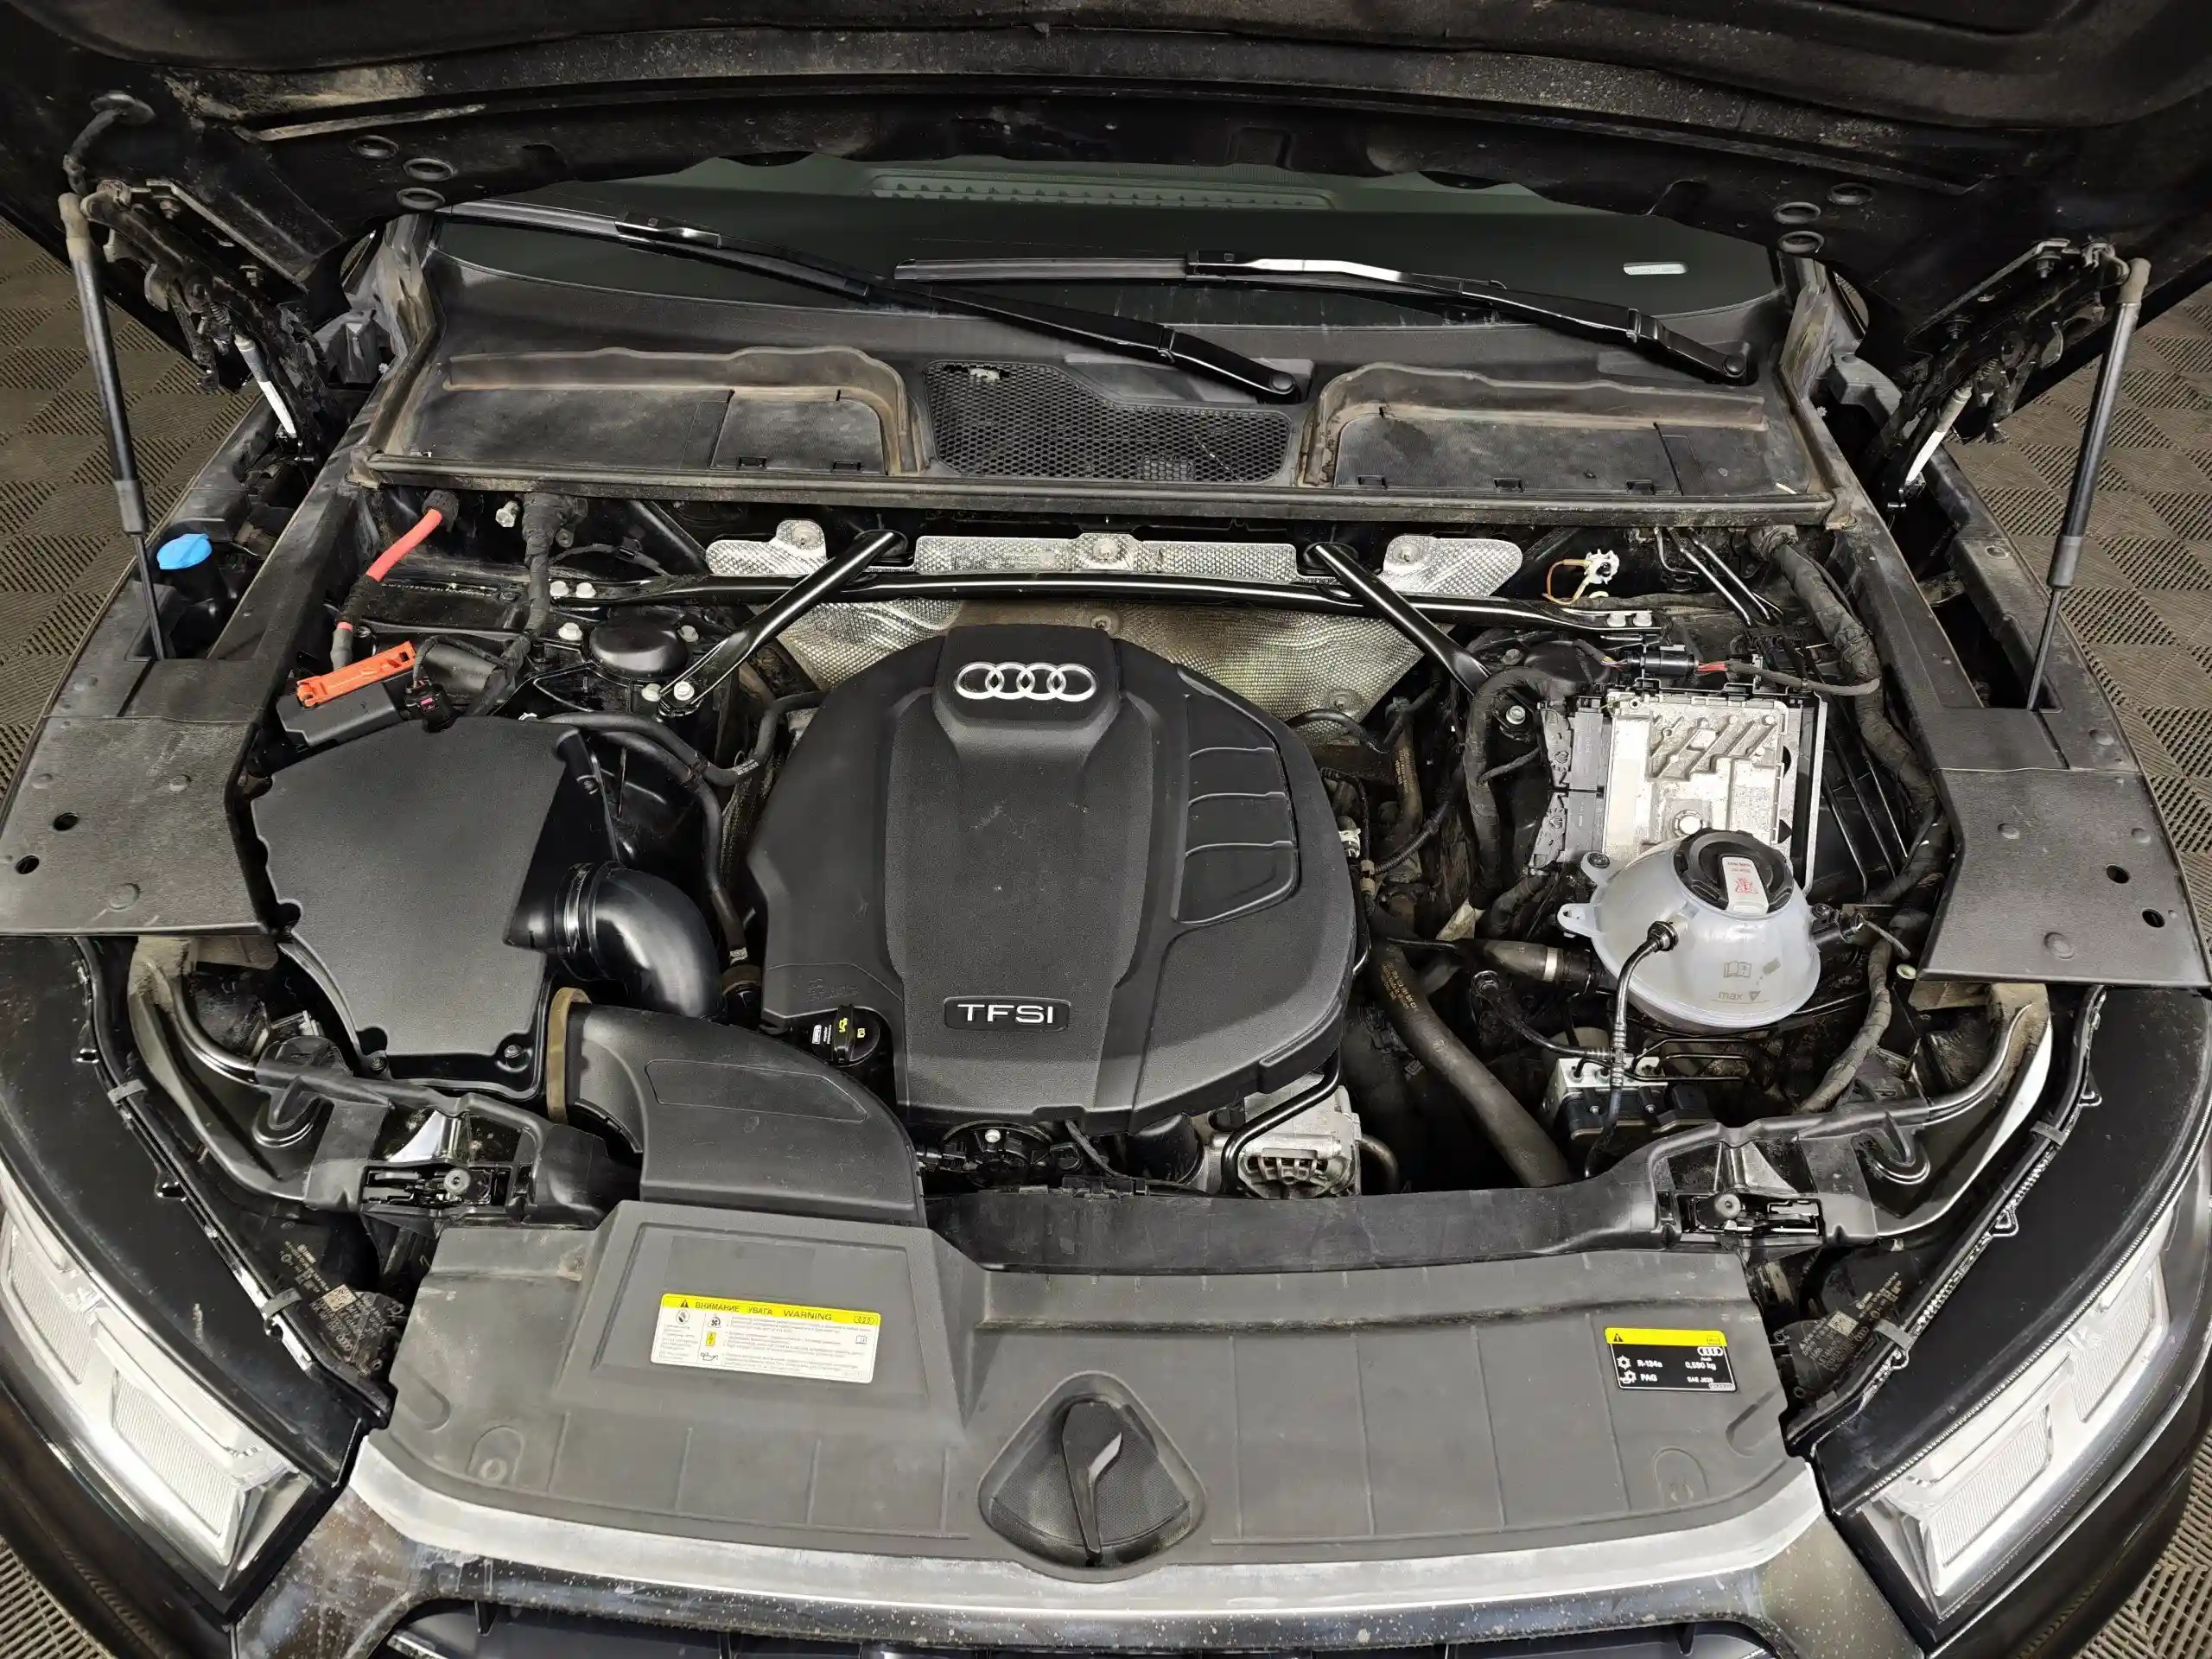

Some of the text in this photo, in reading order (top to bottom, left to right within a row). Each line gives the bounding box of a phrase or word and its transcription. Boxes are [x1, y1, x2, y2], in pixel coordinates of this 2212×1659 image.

[1718, 991, 1743, 1001] max
[957, 1004, 1053, 1024] TFSI
[695, 1301, 832, 1321] ВНИМАНИЕ УВАГА WARNING
[1707, 1362, 1716, 1370] kg
